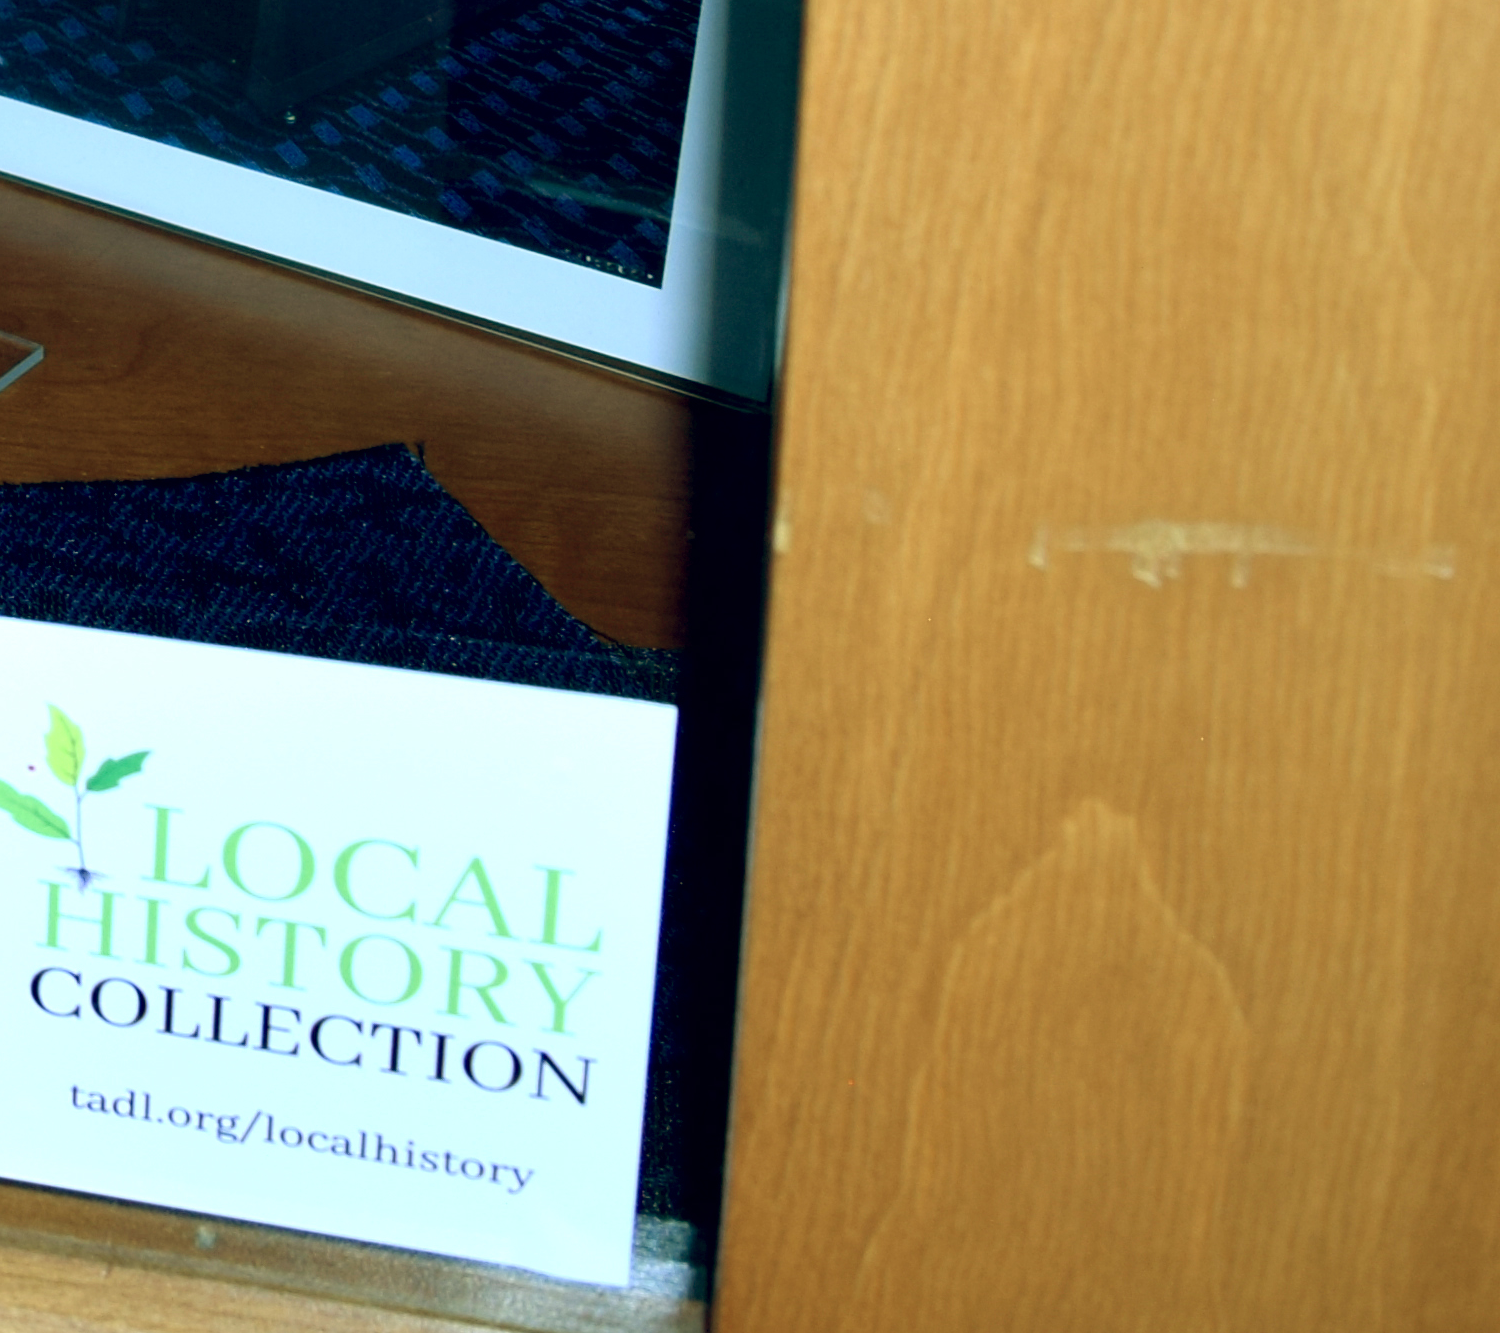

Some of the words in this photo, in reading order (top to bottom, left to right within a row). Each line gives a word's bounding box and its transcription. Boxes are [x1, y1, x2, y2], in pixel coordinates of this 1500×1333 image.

[141, 802, 605, 955] LOCAL
[36, 877, 605, 1037] HISTORY
[29, 965, 598, 1108] COLLECTION
[69, 1079, 536, 1196] tadl.org/localhistory
